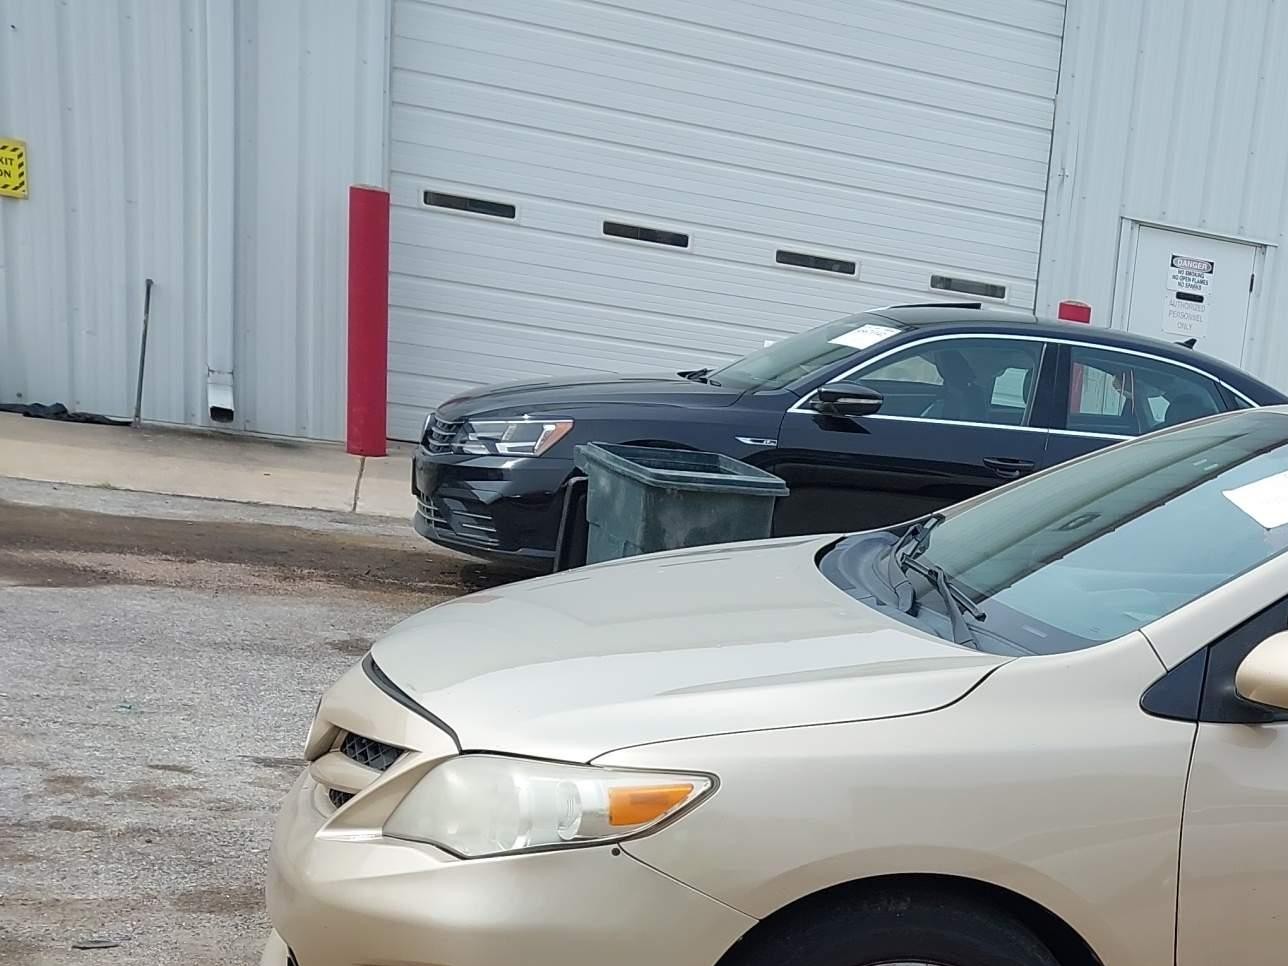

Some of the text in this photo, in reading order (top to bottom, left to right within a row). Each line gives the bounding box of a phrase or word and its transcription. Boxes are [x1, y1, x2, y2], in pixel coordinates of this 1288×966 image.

[1177, 259, 1207, 270] DANGER
[1169, 298, 1206, 312] AUTHORIZED
[1168, 310, 1203, 322] PERSONNEL
[1177, 321, 1193, 330] ONLY
